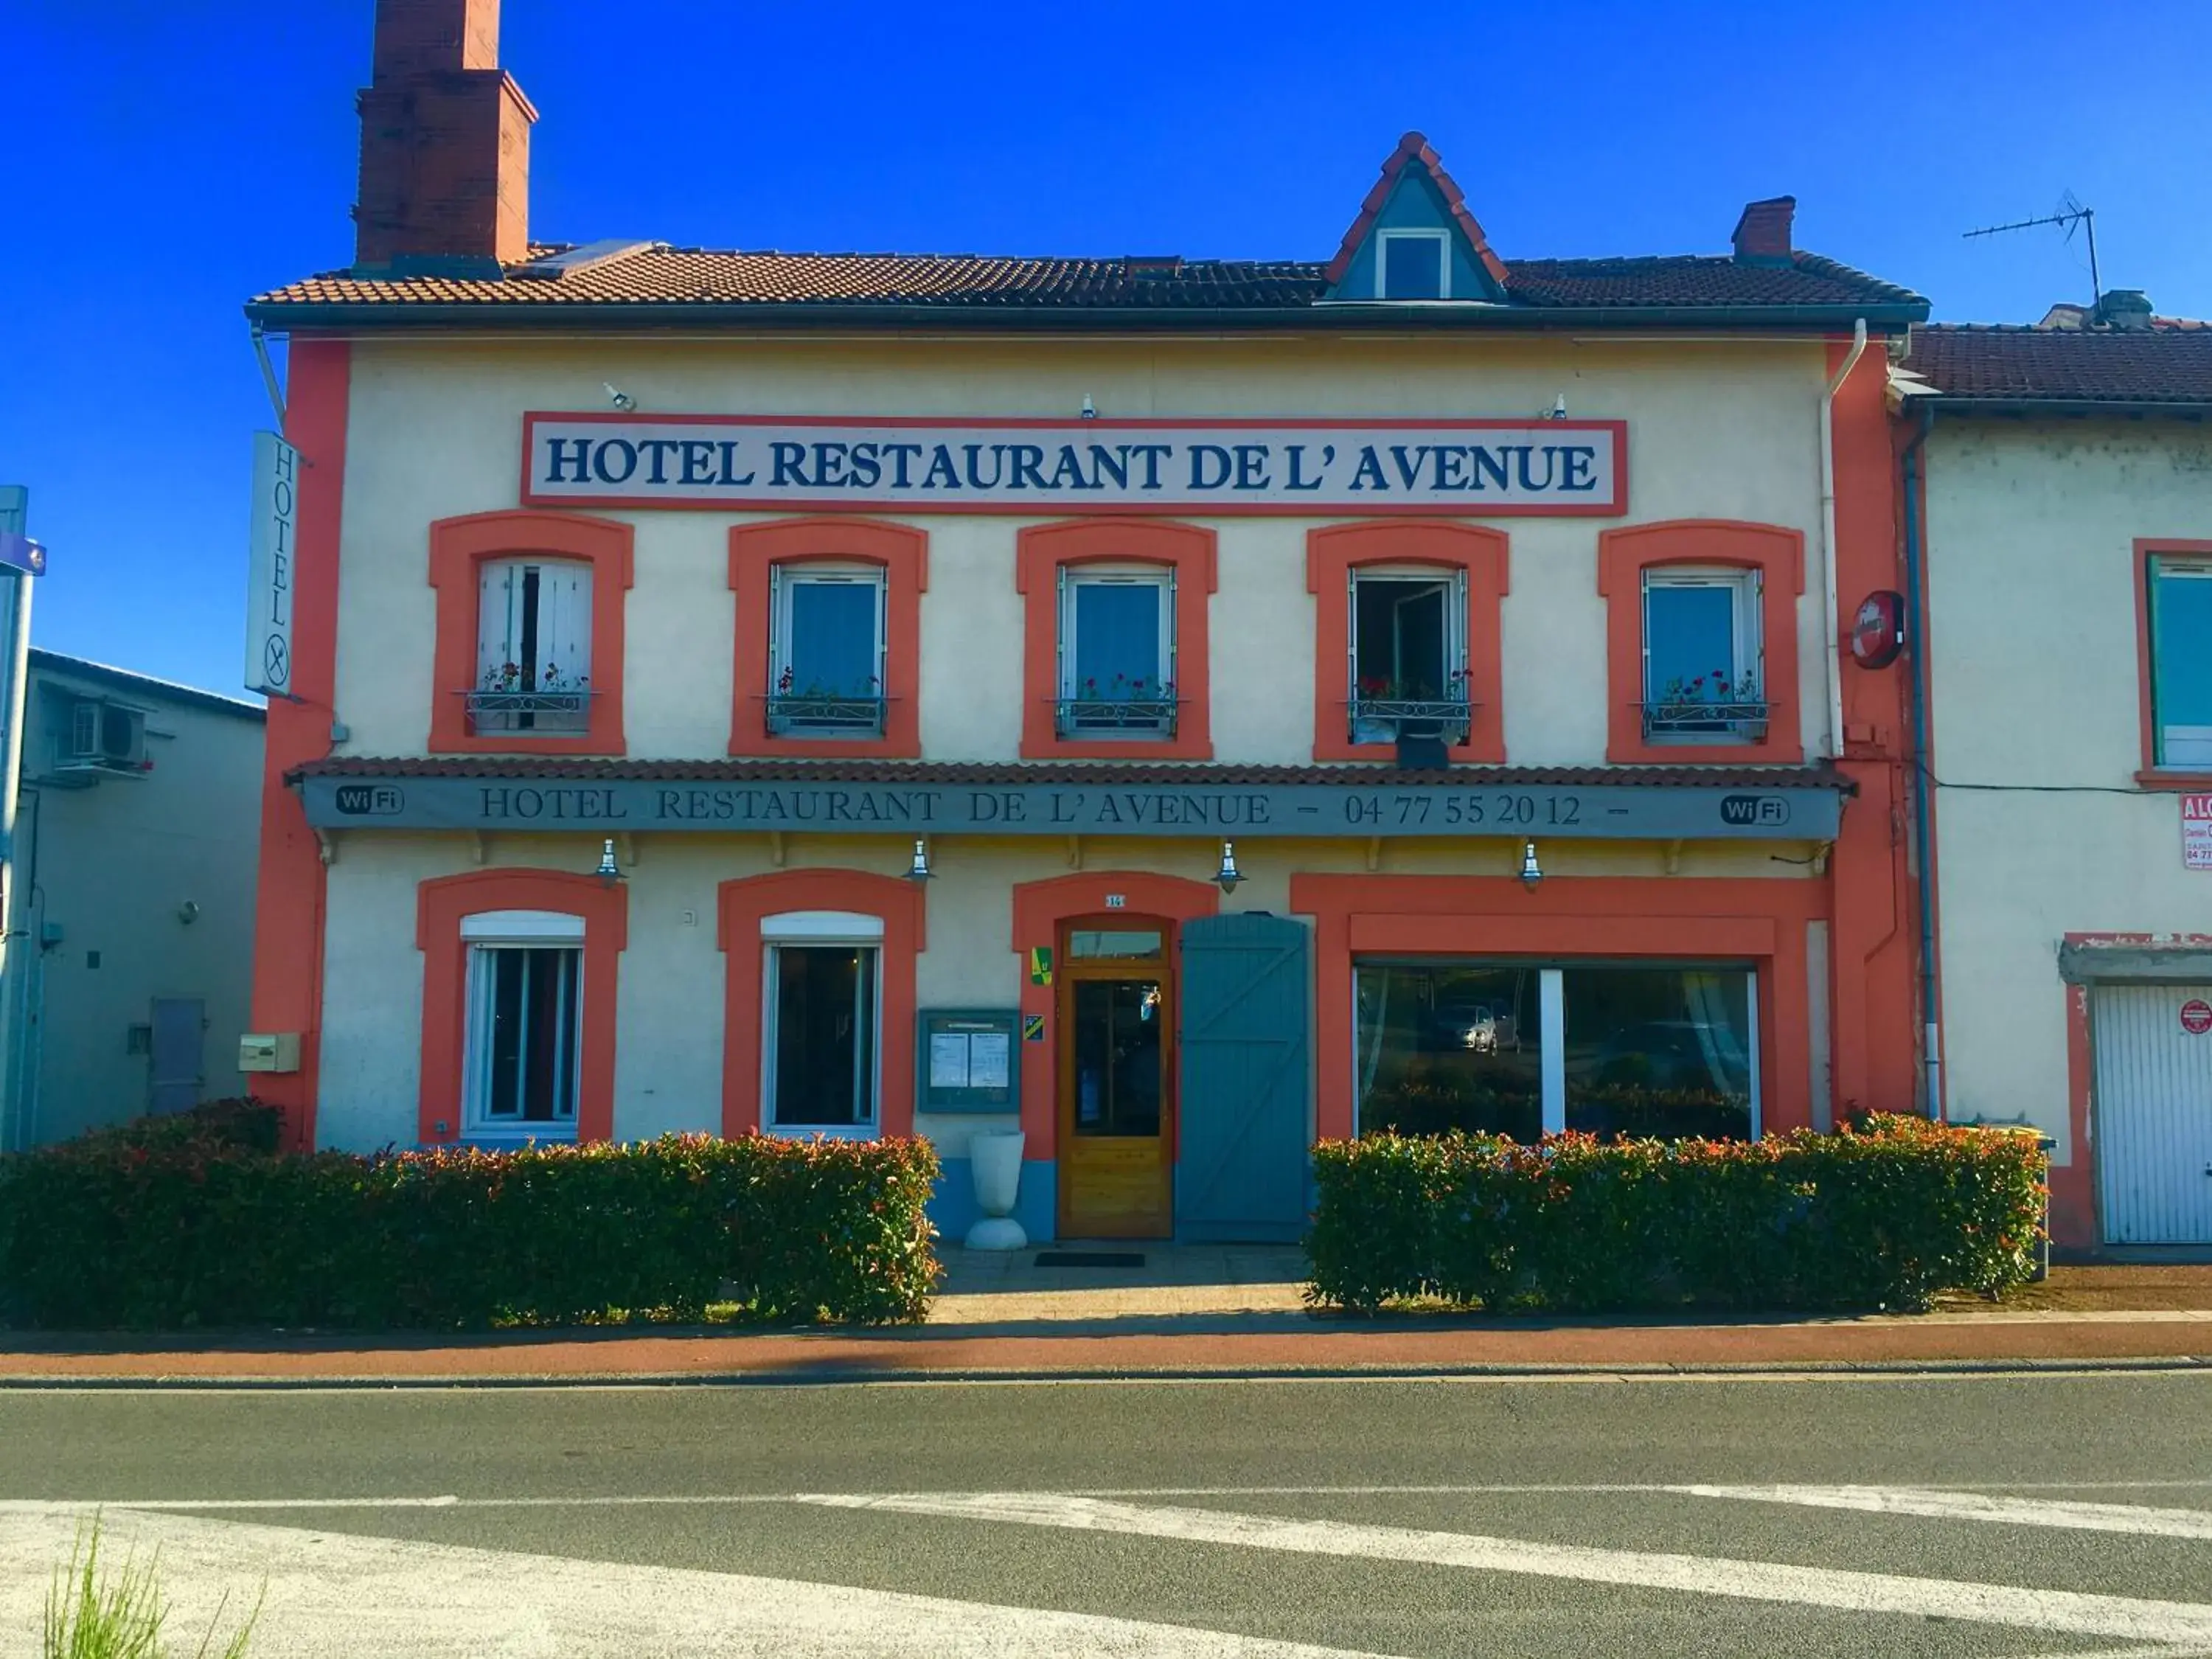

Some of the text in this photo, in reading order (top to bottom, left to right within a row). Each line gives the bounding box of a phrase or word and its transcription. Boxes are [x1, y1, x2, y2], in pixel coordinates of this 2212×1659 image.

[545, 439, 756, 486] HOTEL
[768, 442, 1173, 490] RESTAURANT
[1186, 445, 1271, 490] DE
[272, 442, 293, 627] HOTEL
[479, 788, 627, 818] HOTEL
[655, 790, 942, 821] RESTAURANT
[968, 793, 1026, 822] DE
[1345, 795, 1384, 824] 04
[1394, 795, 1432, 824] 77
[1445, 795, 1484, 824] 55
[1497, 795, 1534, 824] 20
[1546, 796, 1580, 825] 12
